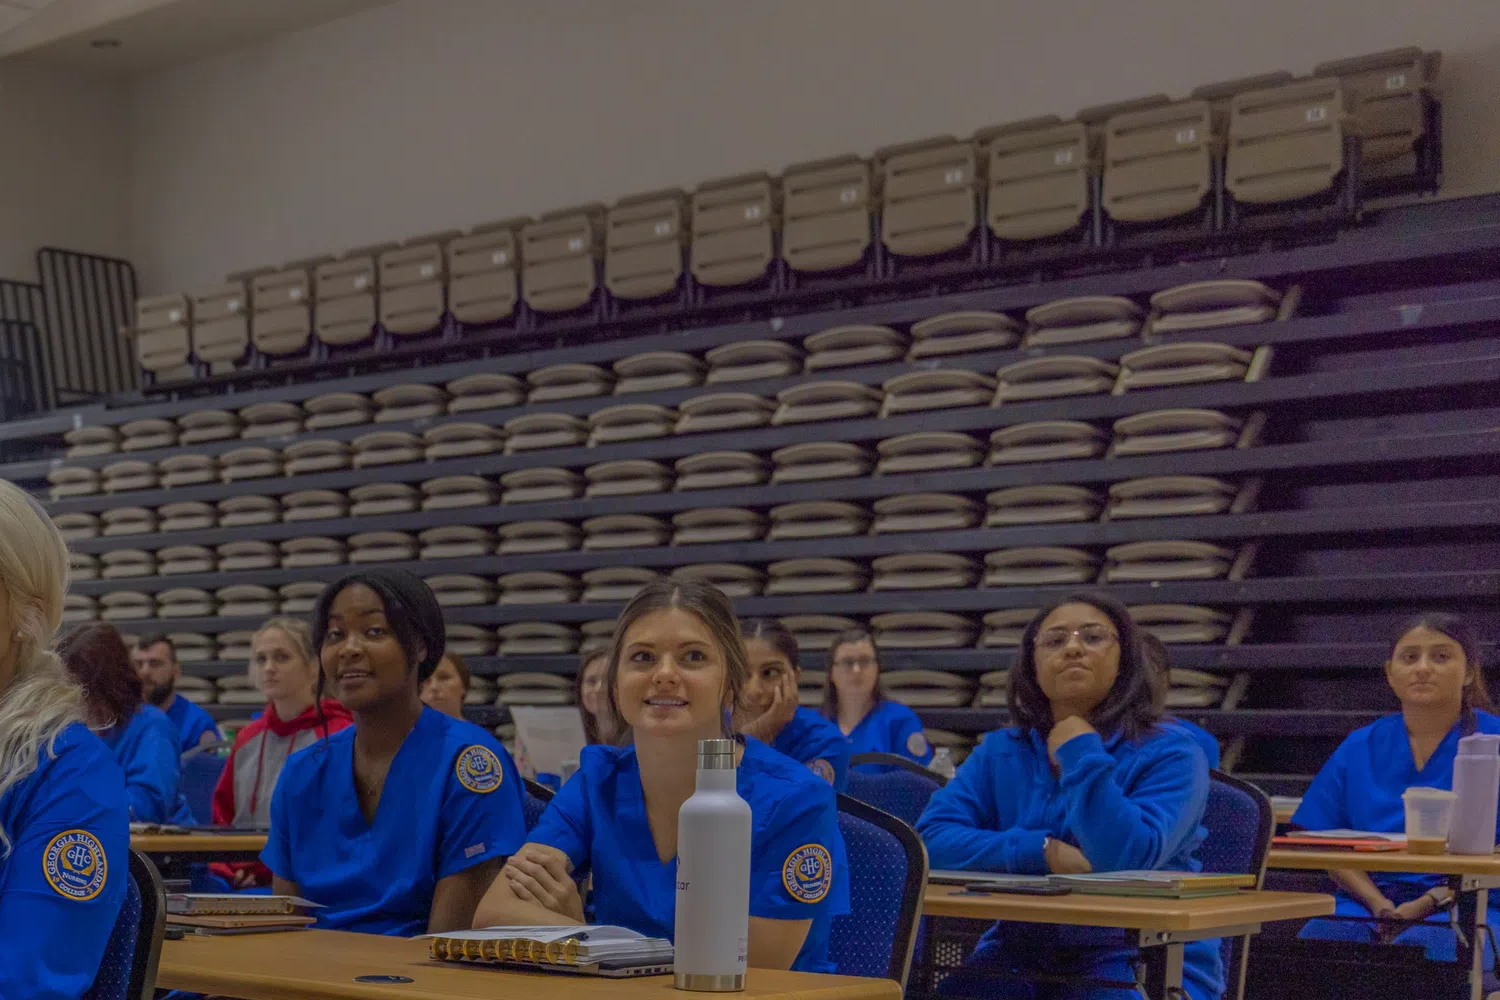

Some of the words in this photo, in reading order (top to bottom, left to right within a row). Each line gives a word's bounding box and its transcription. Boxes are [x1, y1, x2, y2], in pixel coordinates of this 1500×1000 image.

[47, 835, 75, 875] GEORGIA
[76, 833, 104, 889] HIGHLANDS
[67, 846, 91, 867] GHC
[800, 857, 820, 875] GHC
[786, 853, 802, 892] GEORGIA
[802, 847, 830, 881] HIGHLANDS
[59, 883, 86, 896] COLLEGE
